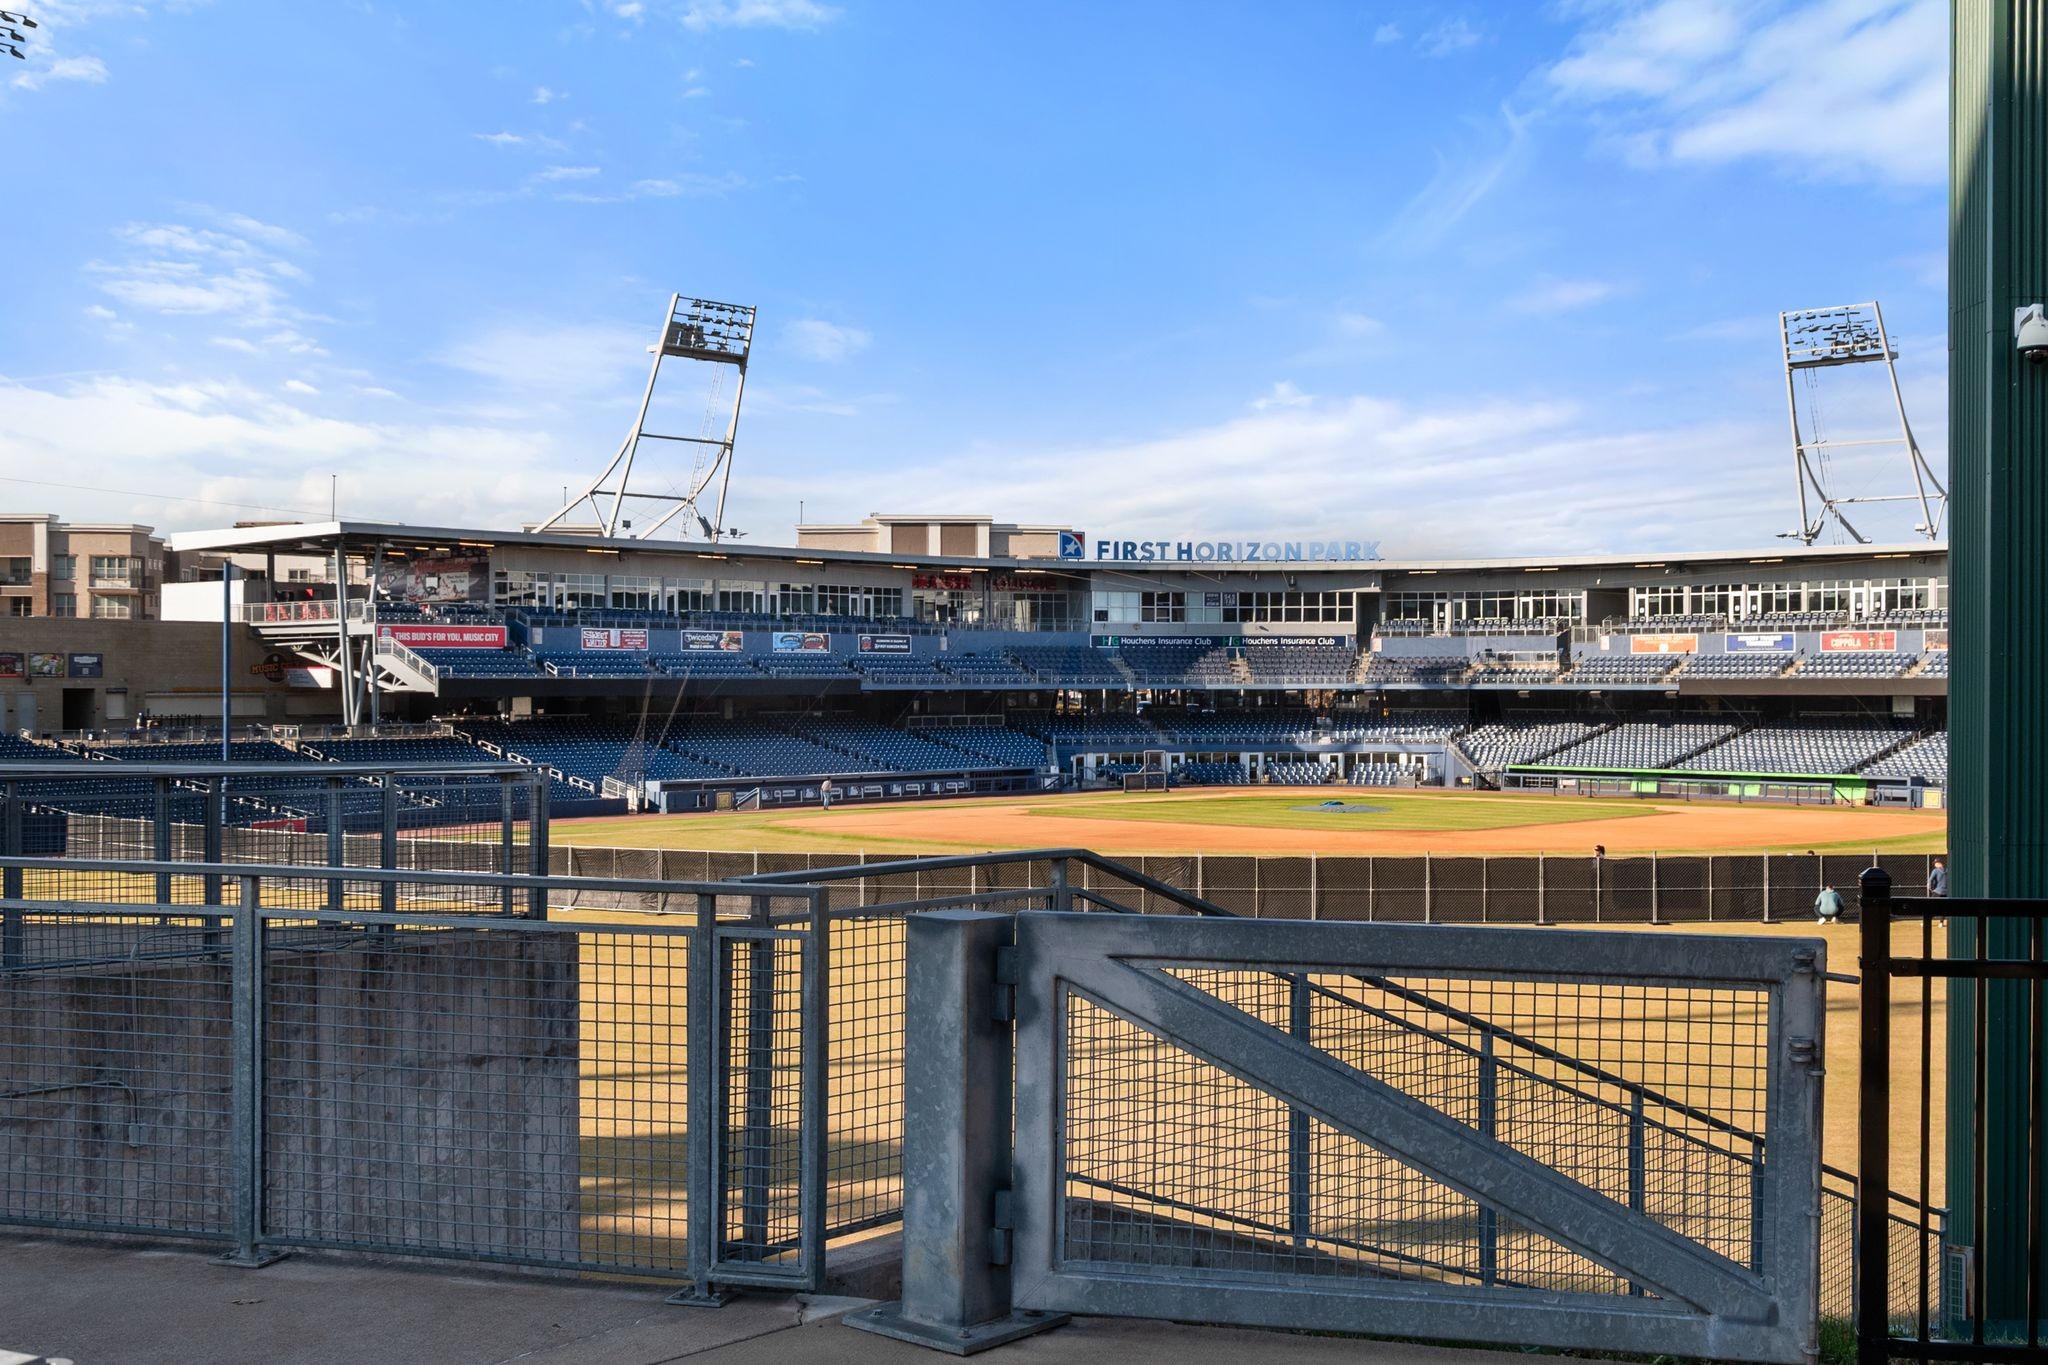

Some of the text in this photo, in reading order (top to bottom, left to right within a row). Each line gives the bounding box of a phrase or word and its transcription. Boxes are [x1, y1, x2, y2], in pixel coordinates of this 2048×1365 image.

[1097, 540, 1383, 561] FIRST HORIZON PARK
[412, 632, 432, 640] BUD'S
[447, 633, 462, 642] YOU,
[464, 633, 484, 642] MUSIC
[485, 634, 499, 642] CITY
[1242, 637, 1278, 645] Houchens
[1280, 637, 1316, 645] Insurance
[1318, 637, 1336, 645] Club
[1831, 638, 1862, 648] COPPOLA
[252, 664, 278, 674] MUSIC
